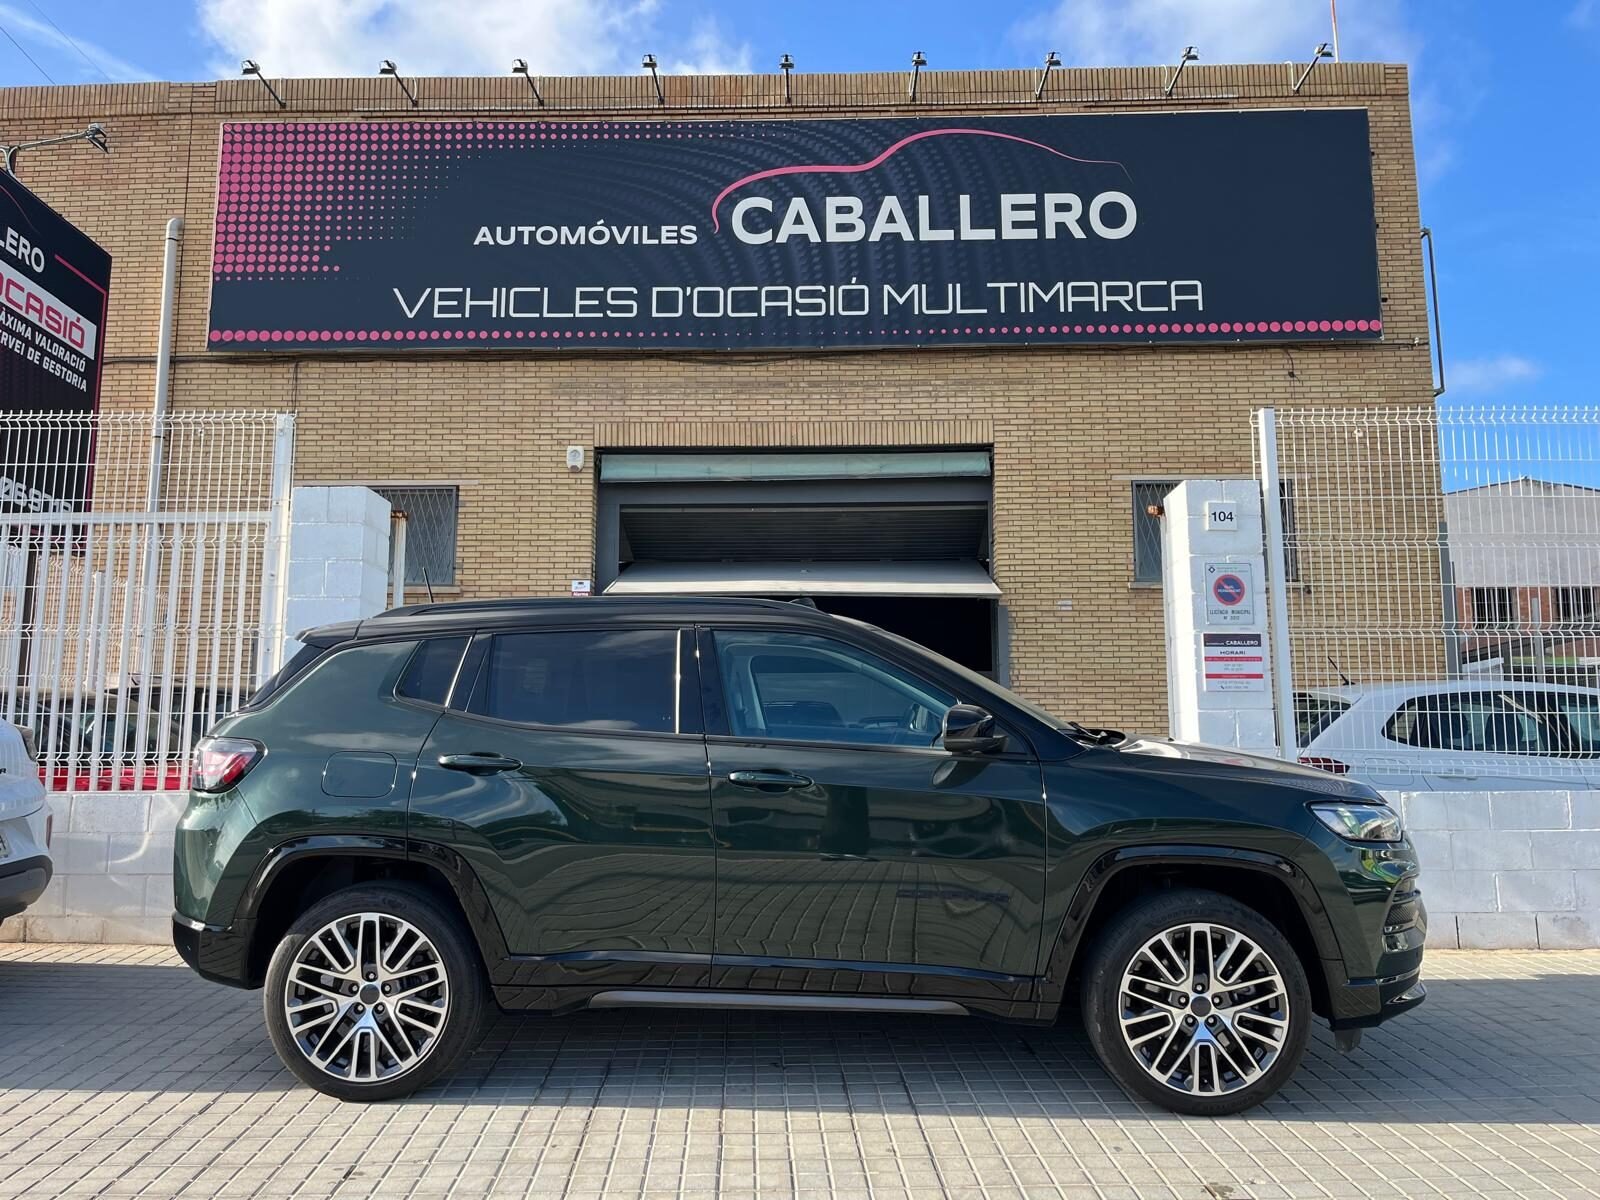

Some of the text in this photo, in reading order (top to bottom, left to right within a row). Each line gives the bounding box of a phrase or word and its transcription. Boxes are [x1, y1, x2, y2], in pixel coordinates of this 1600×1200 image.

[473, 190, 1138, 246] AUTOMÓVILES CABALLERO
[0, 226, 45, 273] ERO
[392, 276, 1204, 320] VEHICLES D'OCASIÓ MULTIMARCA
[0, 329, 87, 393] RVEI DE GESTORIA
[35, 331, 86, 373] VALORACIÓ
[1211, 511, 1234, 522] 104
